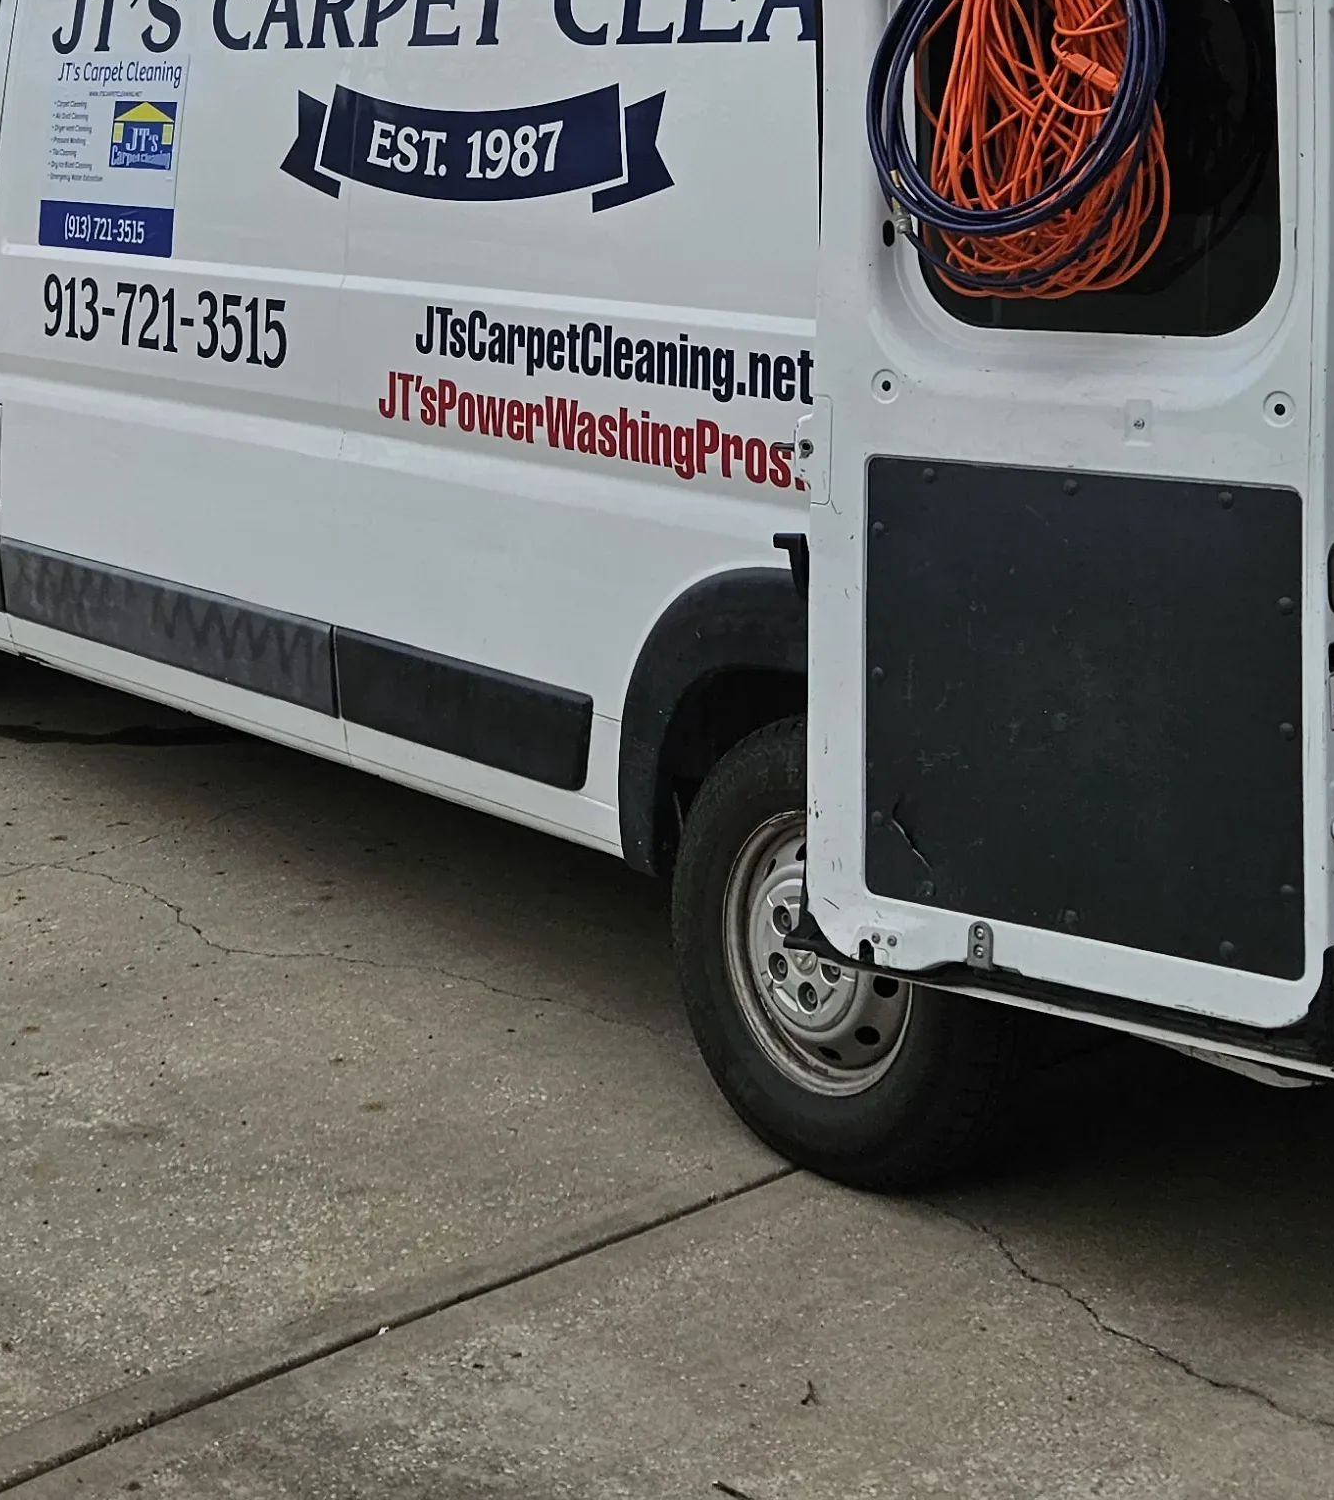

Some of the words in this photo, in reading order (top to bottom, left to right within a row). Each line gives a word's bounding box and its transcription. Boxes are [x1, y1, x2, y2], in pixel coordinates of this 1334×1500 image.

[58, 62, 81, 81] JT's
[84, 61, 123, 87] Carpet
[127, 60, 182, 89] Cleaning
[367, 120, 447, 177] EST.
[466, 120, 564, 179] 1987
[64, 212, 91, 242] (913)
[93, 217, 145, 244] 721-3515
[44, 273, 287, 369] 913-721-3515
[416, 305, 814, 405] JTsCarpetCleaning.net
